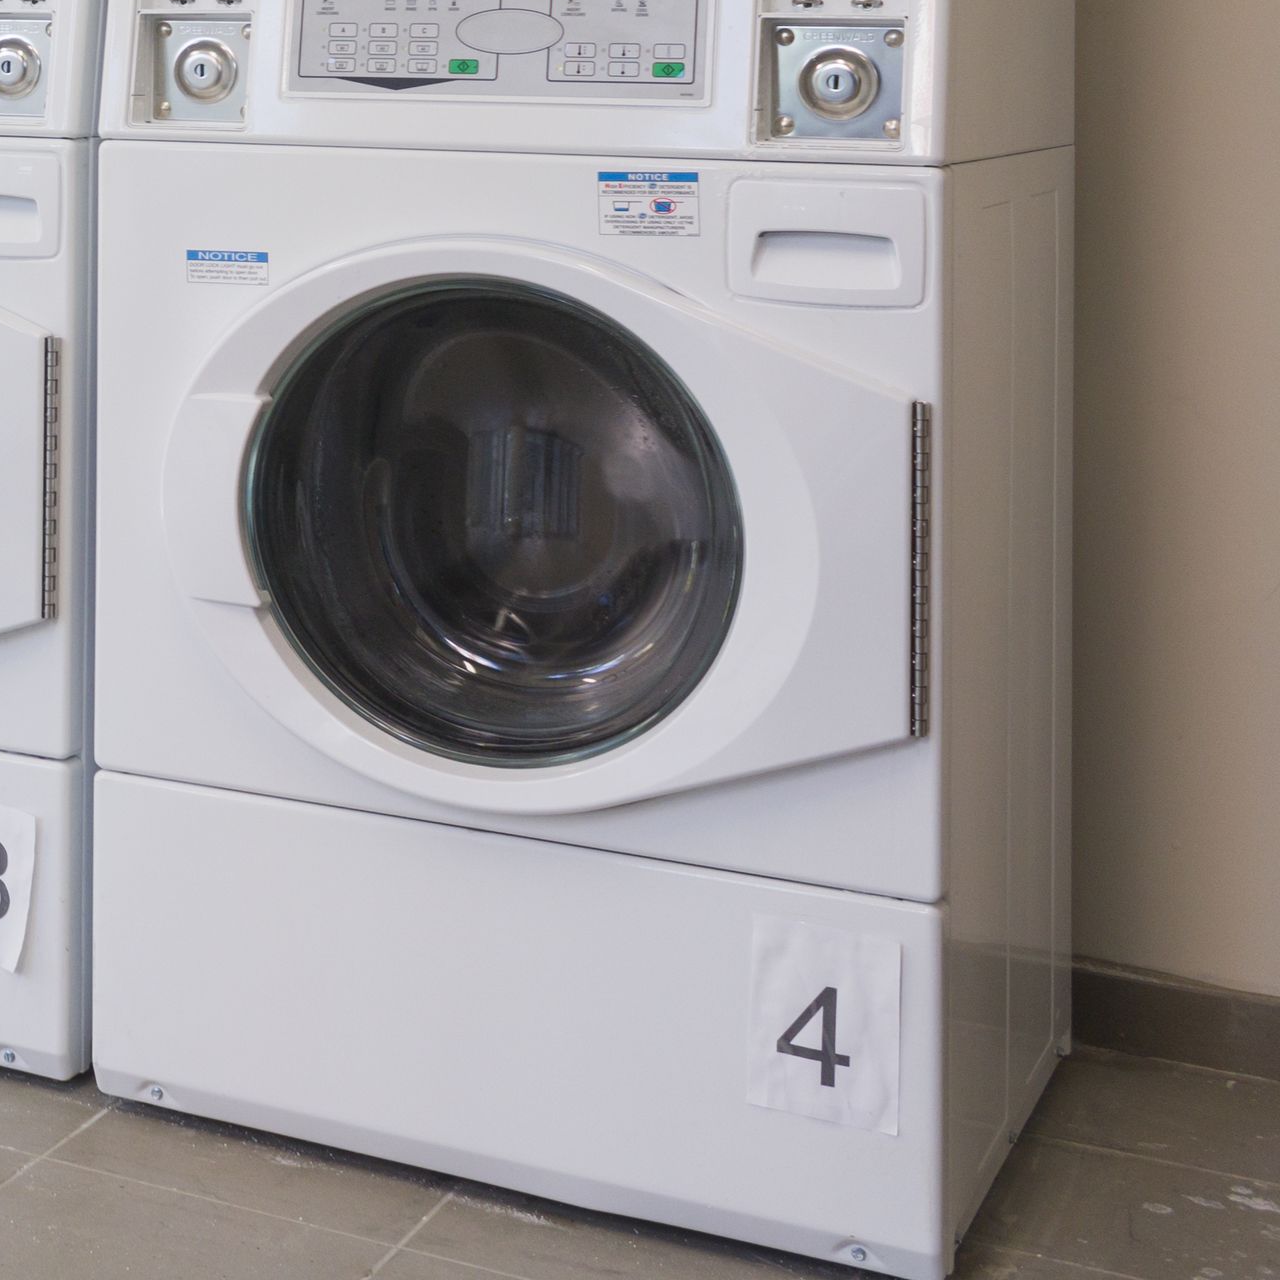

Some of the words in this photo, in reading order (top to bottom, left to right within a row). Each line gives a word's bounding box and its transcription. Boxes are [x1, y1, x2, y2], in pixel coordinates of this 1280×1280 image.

[628, 173, 669, 181] NOTICE
[198, 251, 258, 262] NOTICE
[777, 987, 850, 1087] 4
